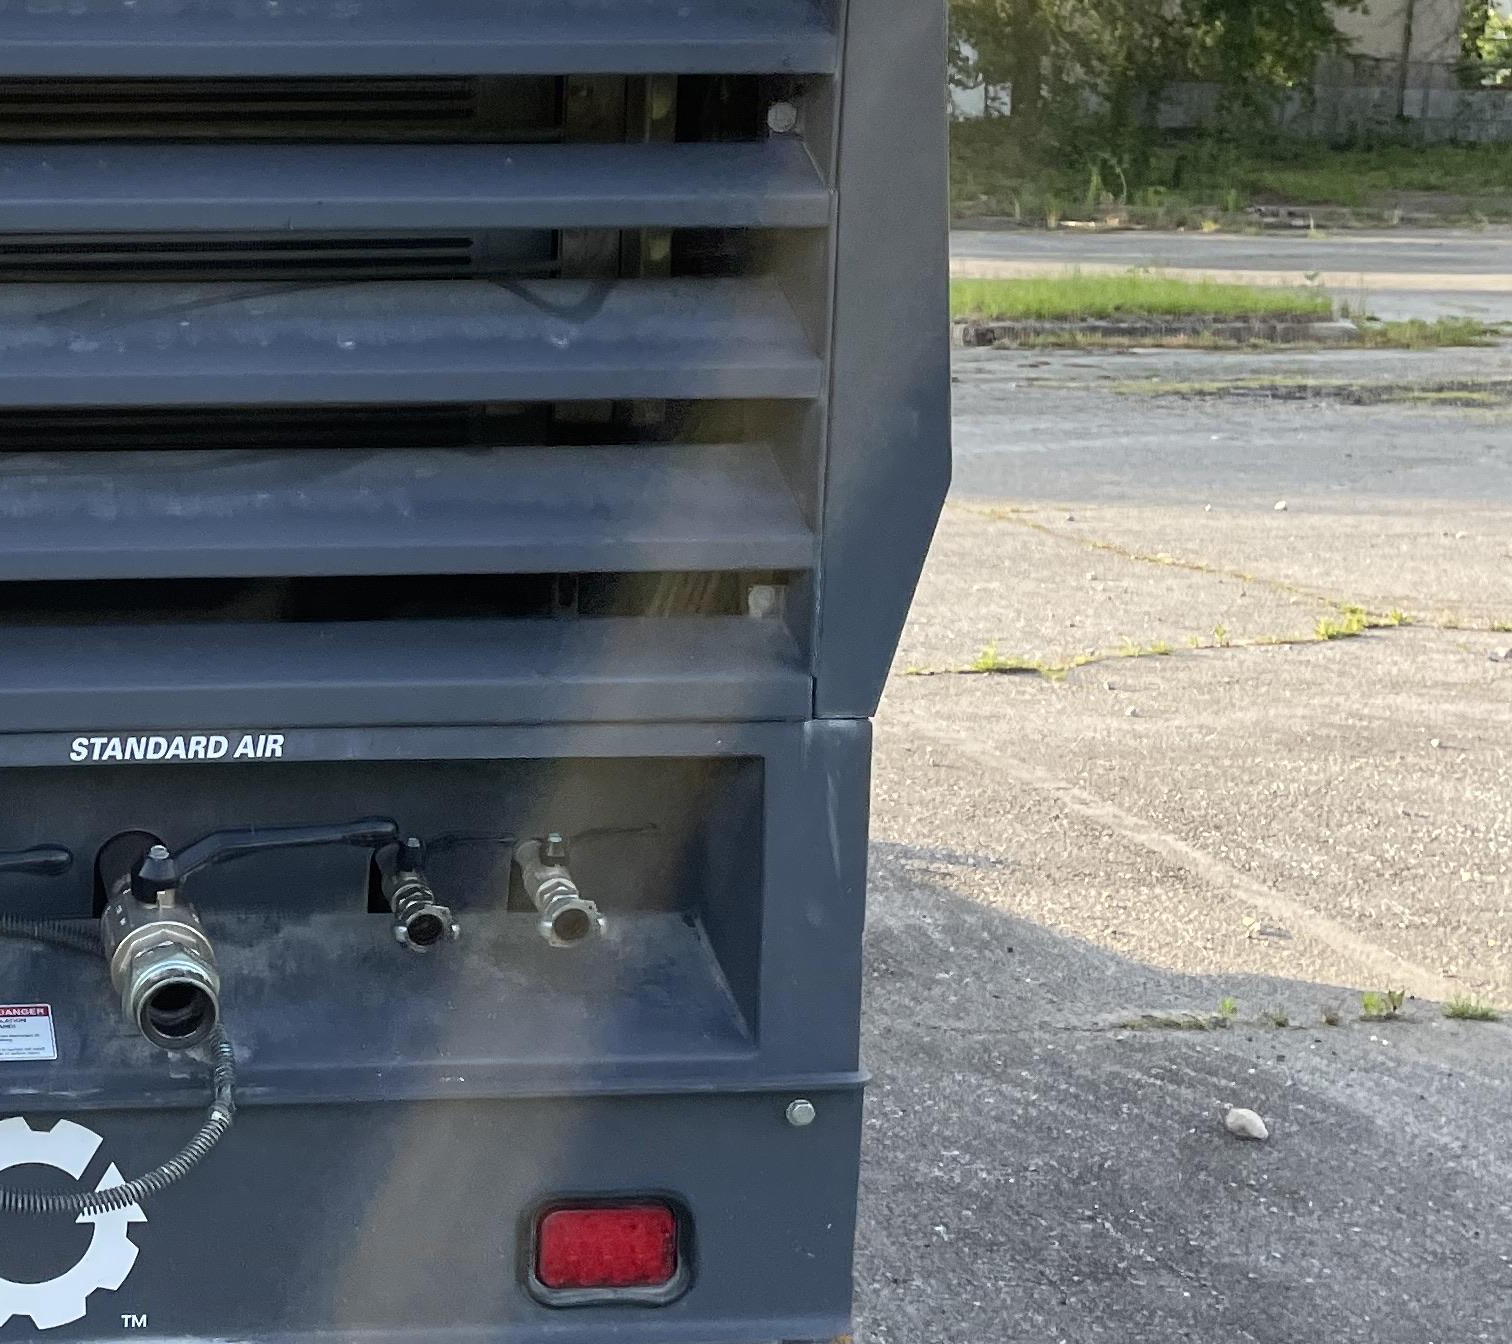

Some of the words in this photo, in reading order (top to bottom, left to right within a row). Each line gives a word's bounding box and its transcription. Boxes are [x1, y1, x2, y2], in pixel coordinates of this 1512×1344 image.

[69, 735, 229, 762] STANDARD
[233, 734, 285, 759] AIR
[120, 1314, 147, 1328] TM
